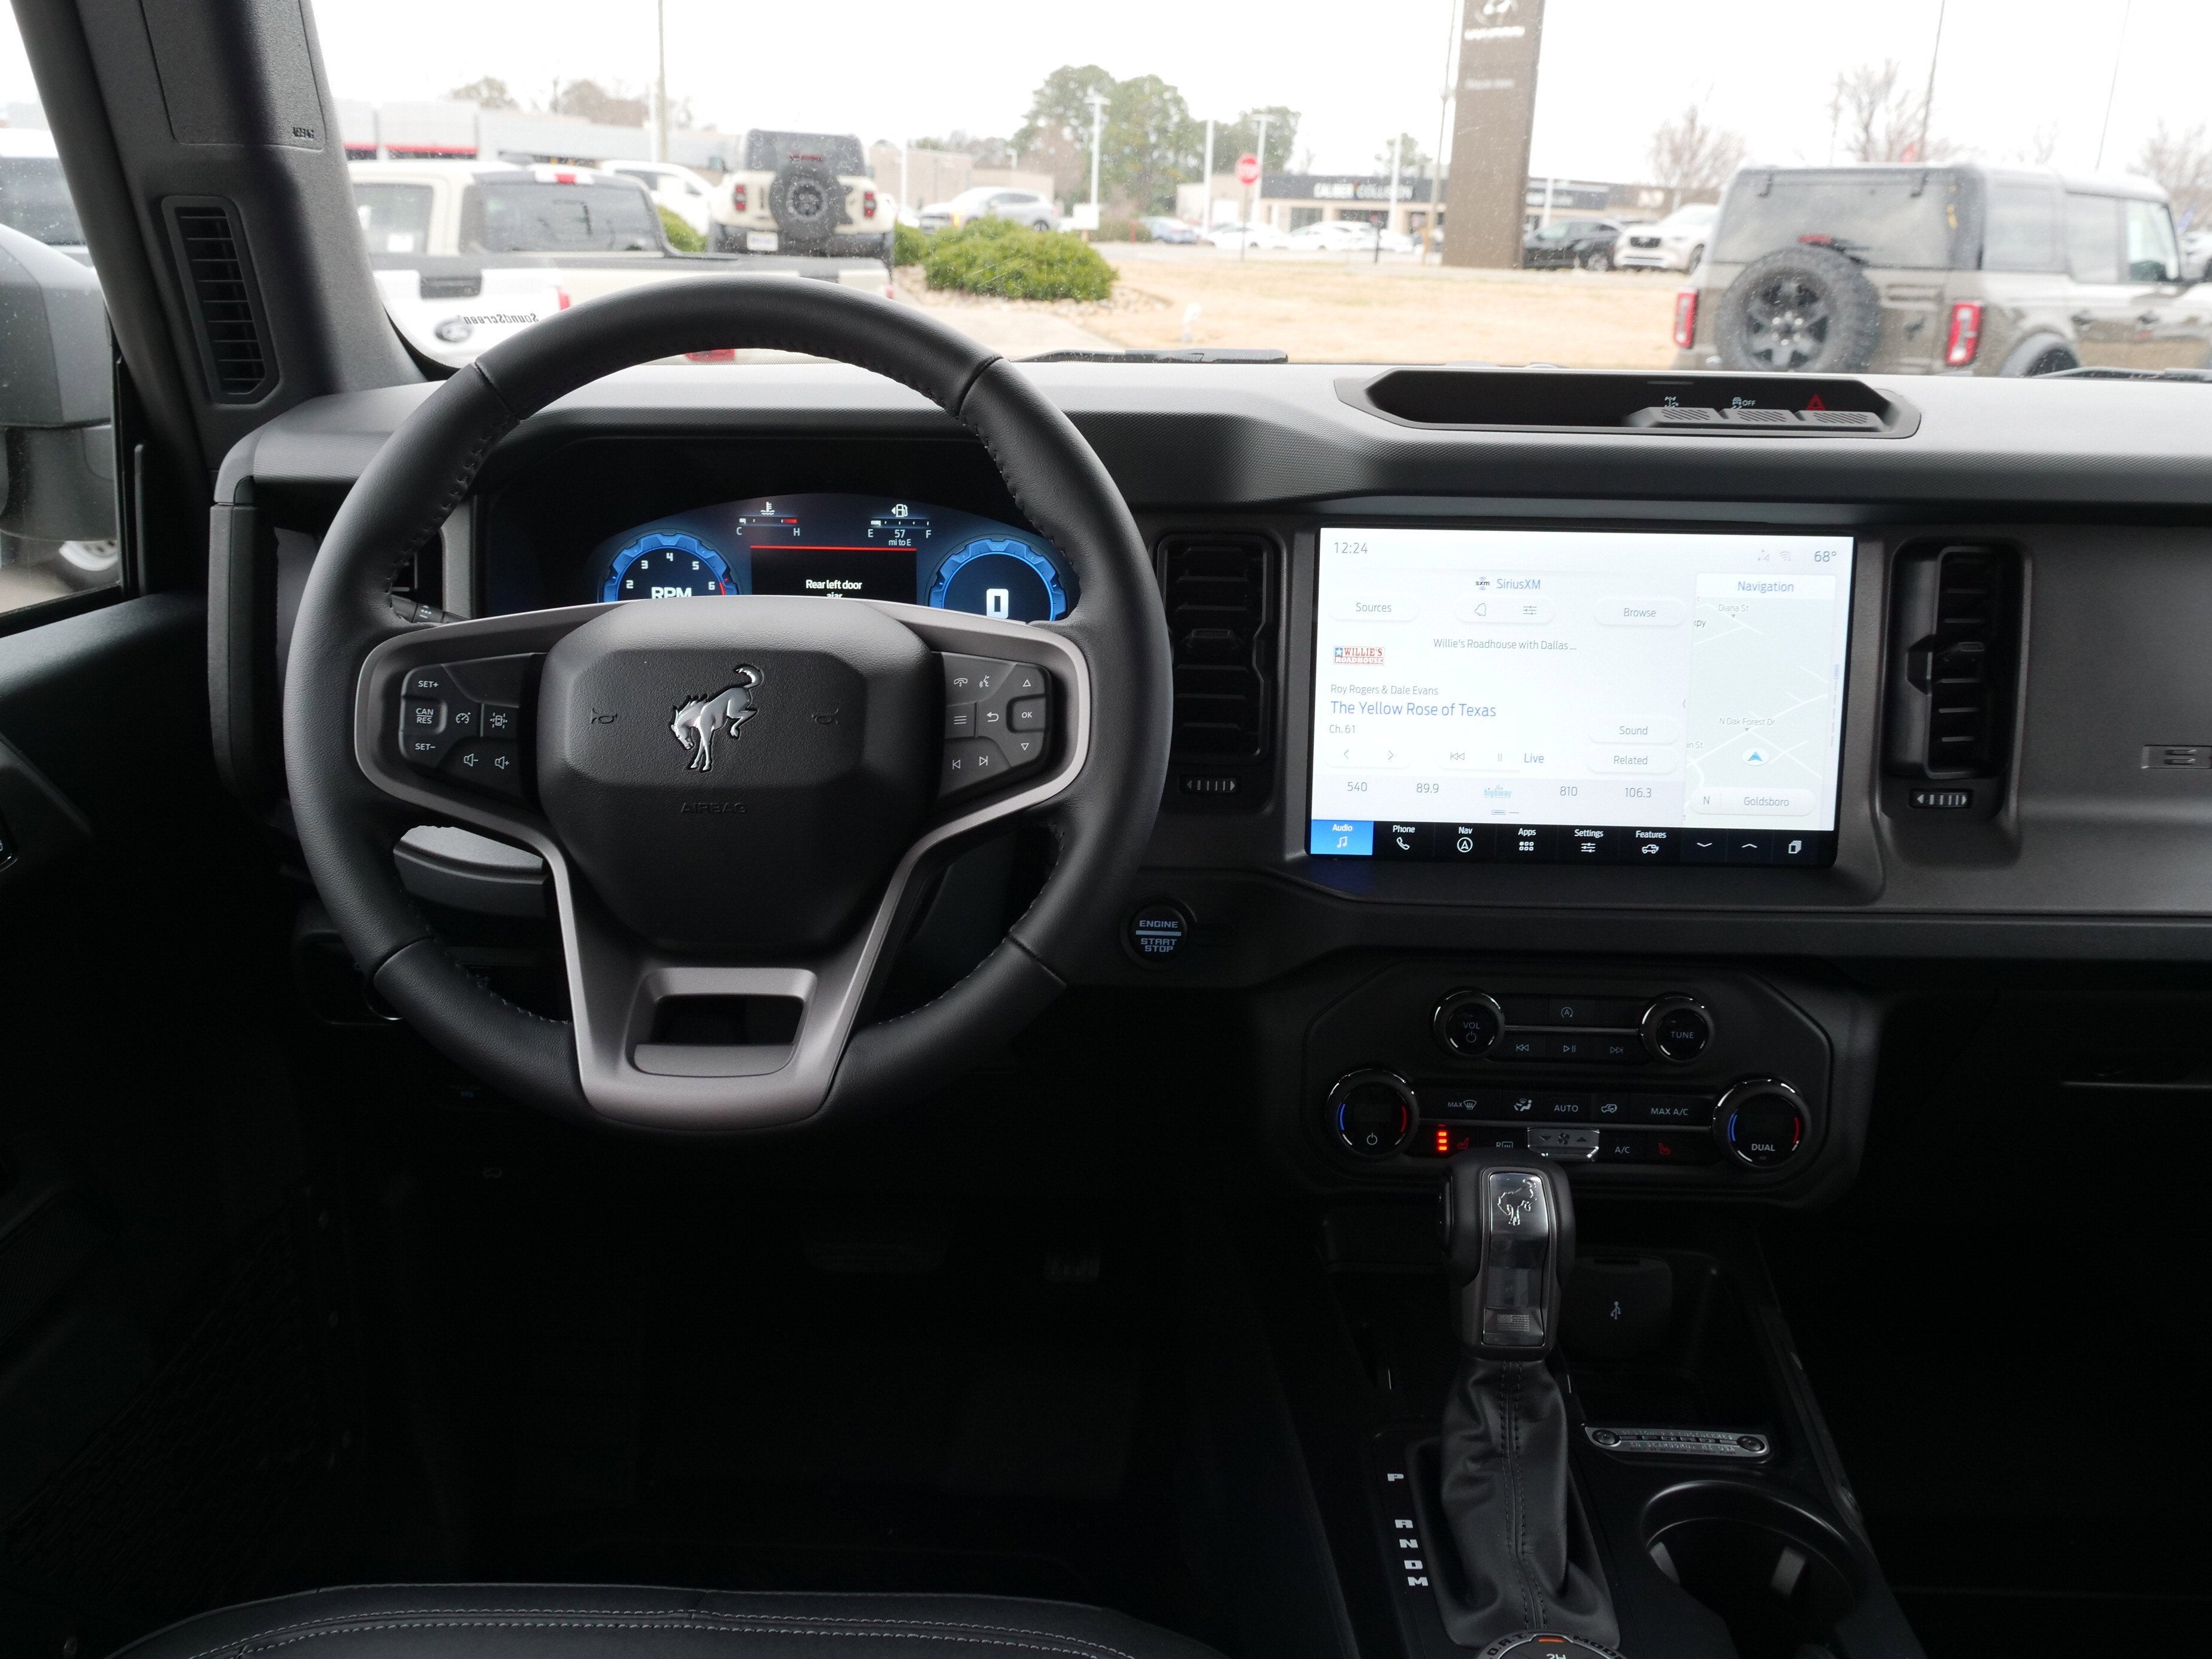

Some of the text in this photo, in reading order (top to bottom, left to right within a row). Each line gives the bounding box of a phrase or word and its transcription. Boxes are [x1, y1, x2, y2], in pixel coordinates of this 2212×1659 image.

[735, 526, 742, 536] C
[793, 527, 800, 537] H
[868, 529, 874, 538] E
[894, 529, 905, 538] 57
[925, 529, 931, 539] F
[888, 538, 897, 546] mi
[1334, 542, 1368, 555] 12:24
[666, 552, 674, 562] 4
[1814, 549, 1837, 563] 68°
[641, 560, 649, 570] 3
[692, 561, 700, 570] 5
[626, 580, 634, 589] 2
[708, 581, 716, 591] 6
[806, 579, 862, 590] Rear left door
[1496, 578, 1542, 590] SiriusXM
[1737, 580, 1795, 594] Navigation
[651, 586, 692, 599] RPM
[986, 588, 1009, 619] 0
[1356, 602, 1393, 613] Sources
[1718, 603, 1750, 613] Diana St
[1623, 607, 1657, 618] Browse
[1433, 638, 1465, 648] Willie's
[1467, 639, 1517, 650] Roadhouse
[1518, 639, 1539, 650] with
[1540, 640, 1569, 651] Dallas
[1344, 647, 1382, 657] WILLIE'S
[1335, 656, 1383, 664] ROADHOUSE
[417, 680, 439, 688] SET+
[1330, 684, 1439, 697] Roy Rogers & Dale Evans
[415, 708, 434, 716] CAN
[1330, 701, 1496, 717] The Yellow Rose of Texas
[416, 716, 433, 725] RES
[1726, 717, 1740, 726] Oak
[1742, 717, 1766, 727] Forest
[1767, 717, 1776, 726] Dr
[1329, 724, 1356, 734] Ch. 61
[1618, 725, 1648, 736] Sound
[1697, 741, 1704, 750] St
[1523, 753, 1545, 764] Live
[1613, 755, 1648, 766] Related
[1347, 781, 1368, 793] 540
[1416, 782, 1440, 794] 89.9
[1559, 786, 1578, 797] 810
[1484, 788, 1512, 798] highway
[1625, 787, 1652, 799] 106.3
[1703, 796, 1710, 806] N
[1744, 796, 1790, 807] Goldsboro
[680, 802, 748, 814] AIRBAG
[1332, 823, 1353, 832] Audio
[1392, 824, 1415, 834] Phone
[1458, 826, 1473, 835] Nav
[1518, 827, 1537, 838] Apps
[1574, 828, 1604, 839] Settings
[1635, 830, 1667, 839] Features
[1139, 919, 1179, 928] ENGINE
[1140, 937, 1178, 946] START
[1144, 945, 1174, 953] STOP
[1463, 1021, 1481, 1030] VOL
[1670, 1030, 1694, 1040] TUNE
[1554, 1104, 1579, 1113] AUTO
[1650, 1107, 1689, 1117] MAX A/C
[1614, 1145, 1631, 1155] A/C
[1750, 1143, 1776, 1152] DUAL
[1387, 1472, 1405, 1482] P
[1394, 1519, 1413, 1529] R
[1399, 1539, 1419, 1549] N
[1403, 1559, 1424, 1570] D
[1407, 1576, 1429, 1587] M
